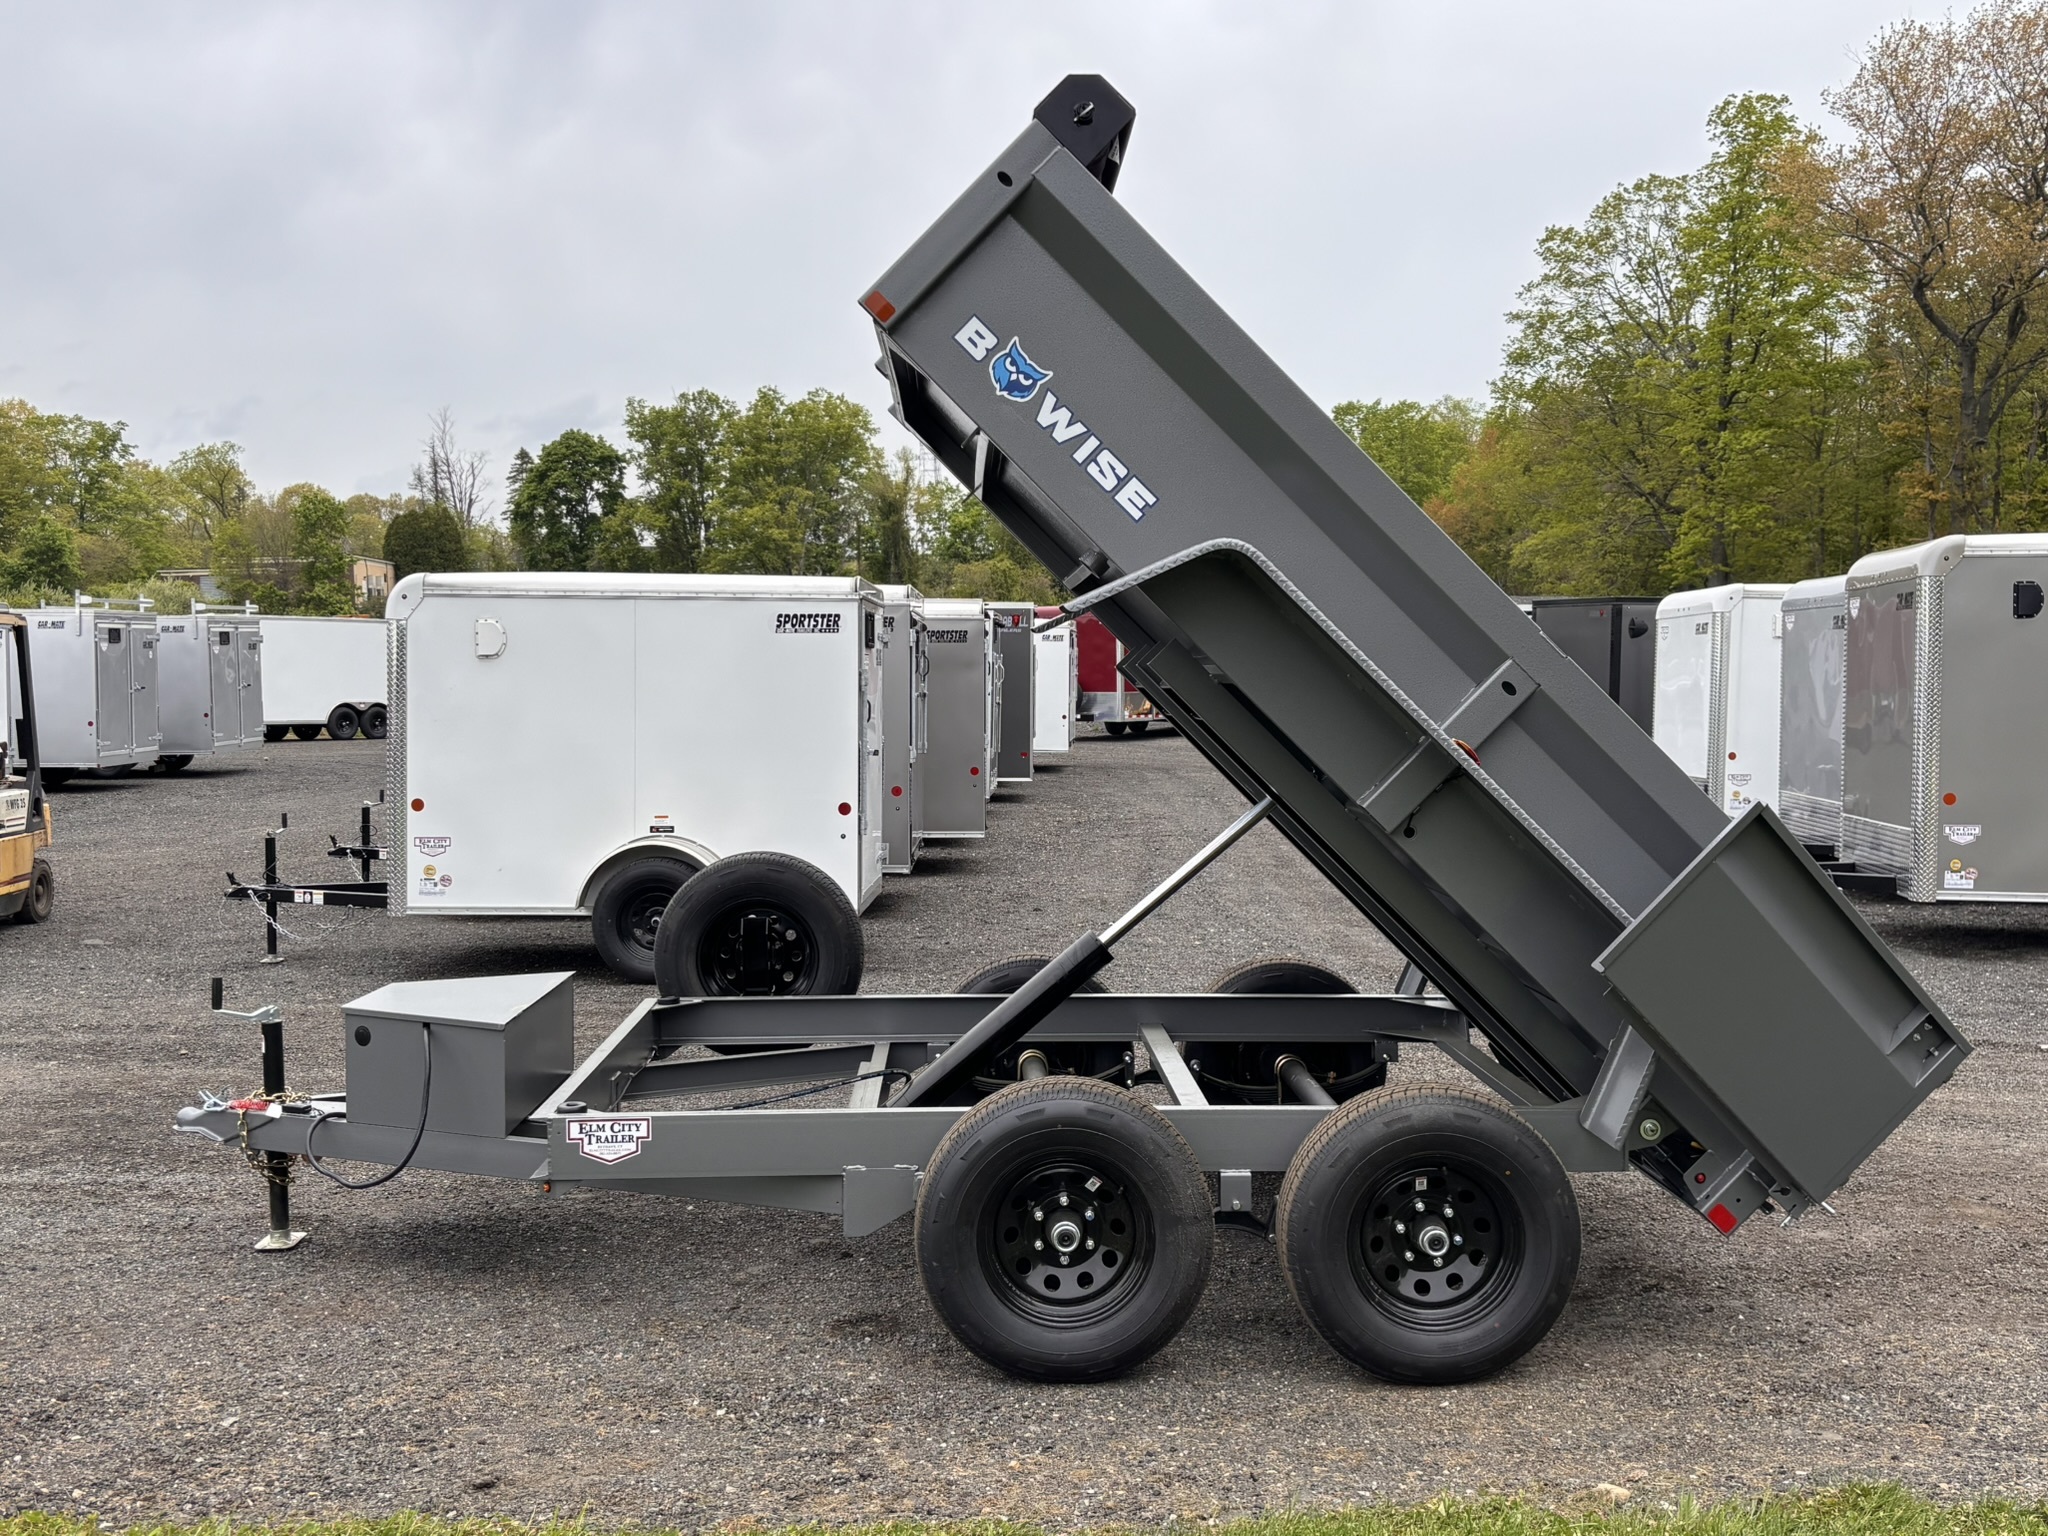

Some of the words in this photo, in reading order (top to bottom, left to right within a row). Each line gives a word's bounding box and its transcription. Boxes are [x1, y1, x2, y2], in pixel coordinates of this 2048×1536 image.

[776, 613, 841, 628] SPORTSTER
[926, 630, 968, 640] SPORTSTER
[578, 1122, 606, 1134] ELM
[609, 1122, 642, 1133] CITY
[585, 1133, 635, 1145] TRAILER
